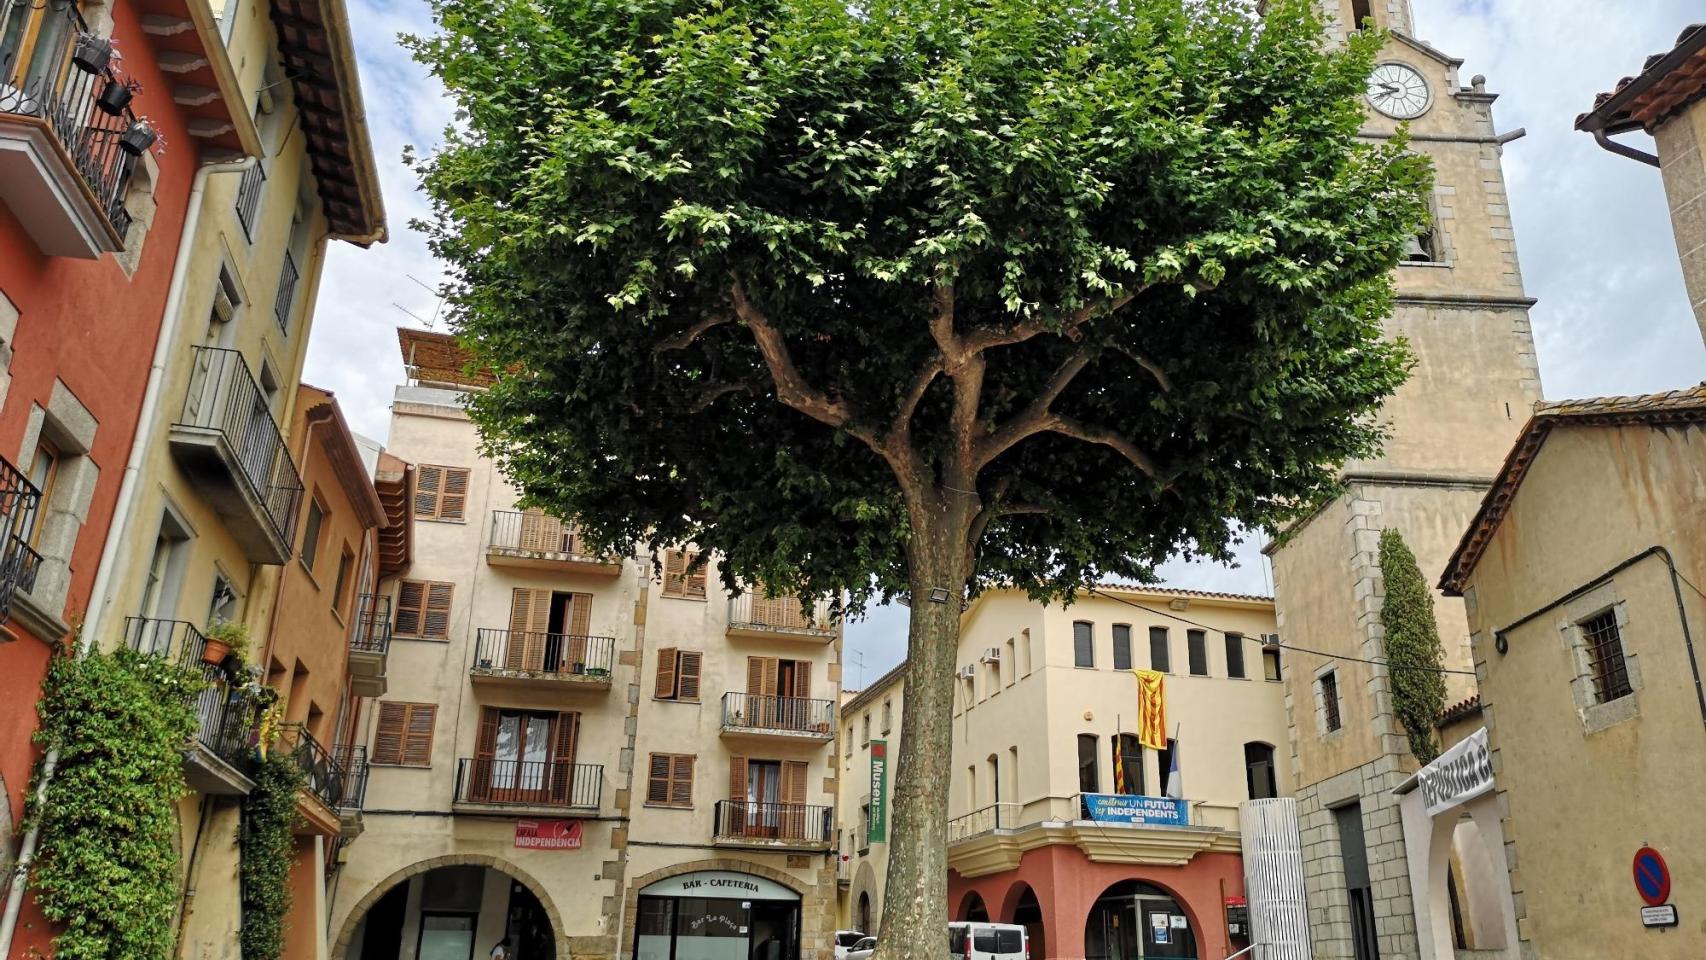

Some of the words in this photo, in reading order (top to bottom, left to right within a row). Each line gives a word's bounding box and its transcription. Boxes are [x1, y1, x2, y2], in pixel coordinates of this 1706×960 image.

[872, 760, 884, 805] Museu
[1420, 750, 1479, 809] REPÚBLICA
[1129, 799, 1143, 808] UN
[1144, 800, 1175, 810] FUTUR
[1107, 806, 1178, 819] INDEPENDENTS
[683, 879, 702, 889] BAR
[710, 879, 759, 892] CAFETERIA
[691, 917, 705, 929] Bar
[706, 914, 717, 922] La
